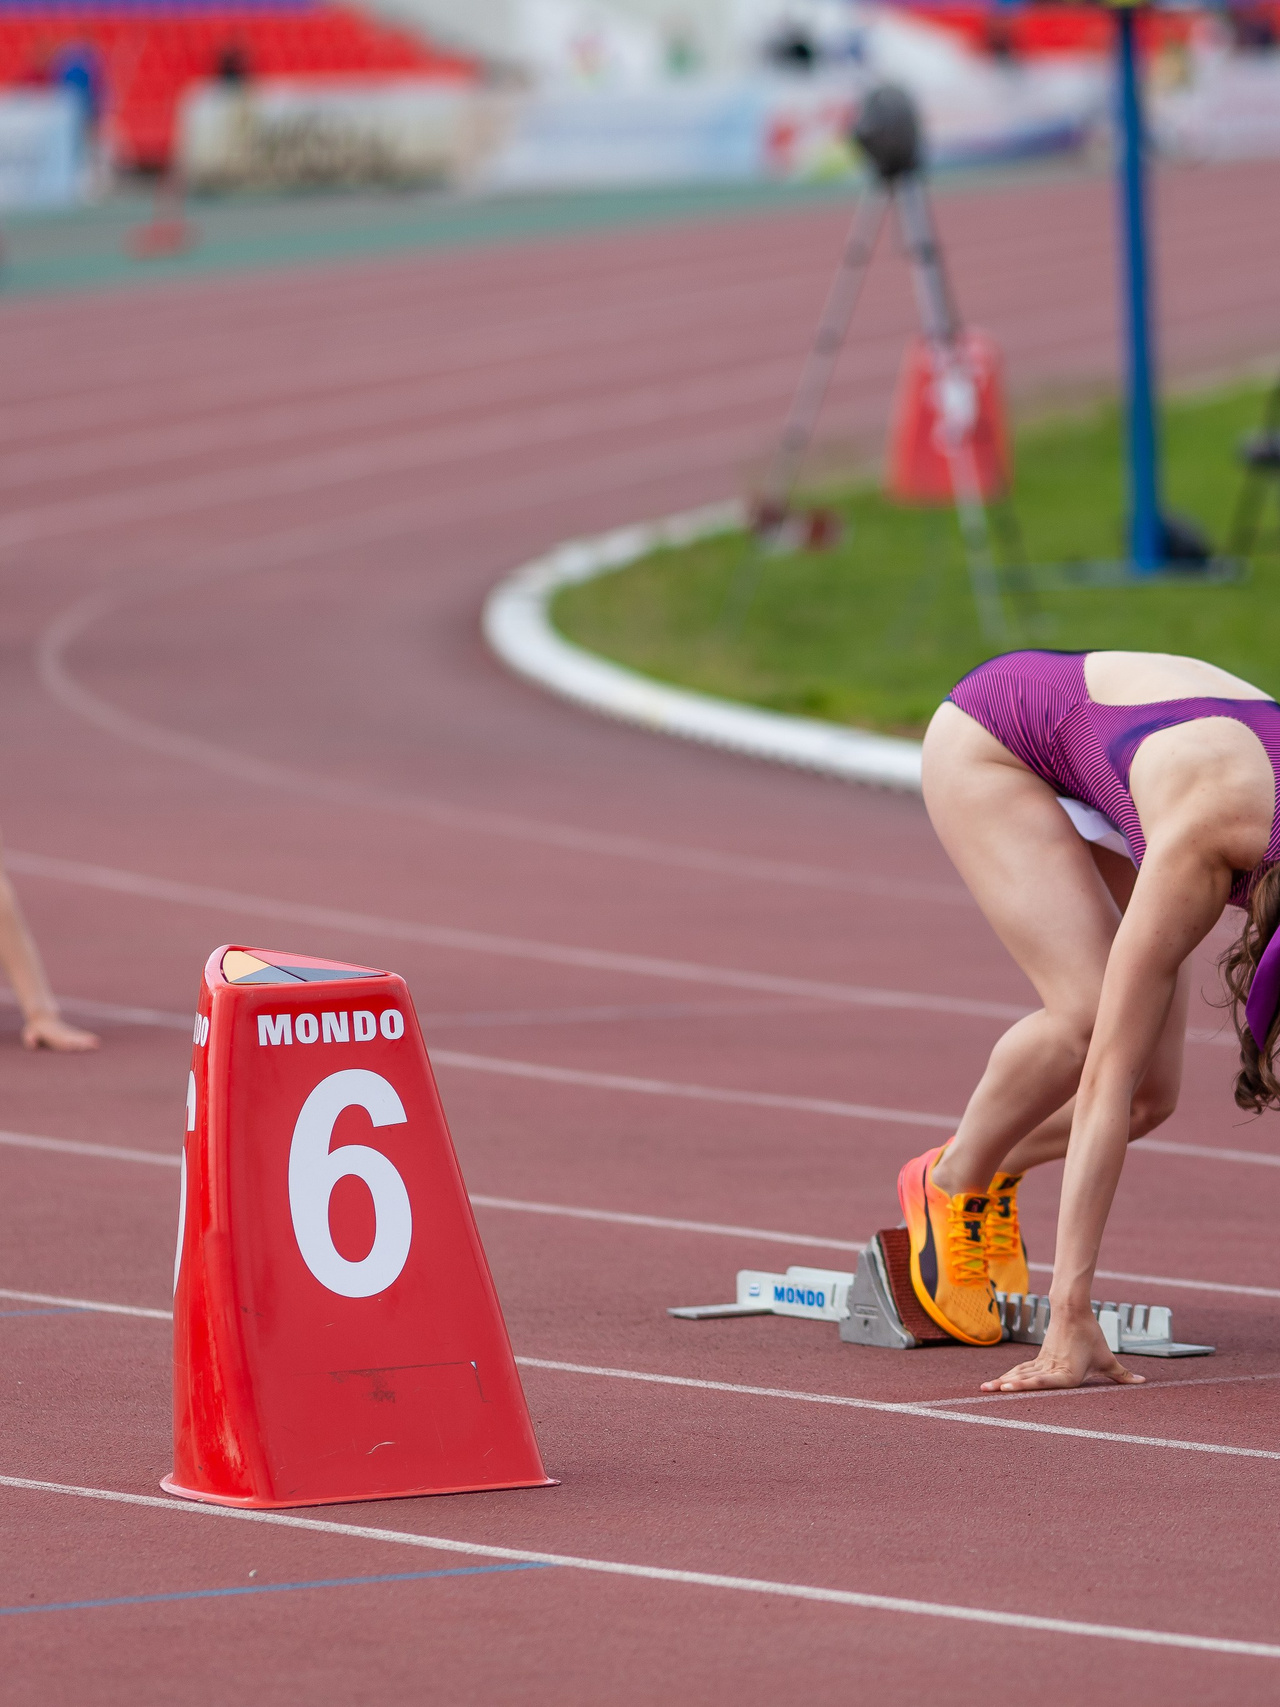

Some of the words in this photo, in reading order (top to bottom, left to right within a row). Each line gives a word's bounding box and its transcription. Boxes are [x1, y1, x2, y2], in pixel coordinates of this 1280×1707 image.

[257, 1008, 405, 1046] MONDO
[288, 1068, 413, 1298] 6
[774, 1285, 825, 1308] MONDO
